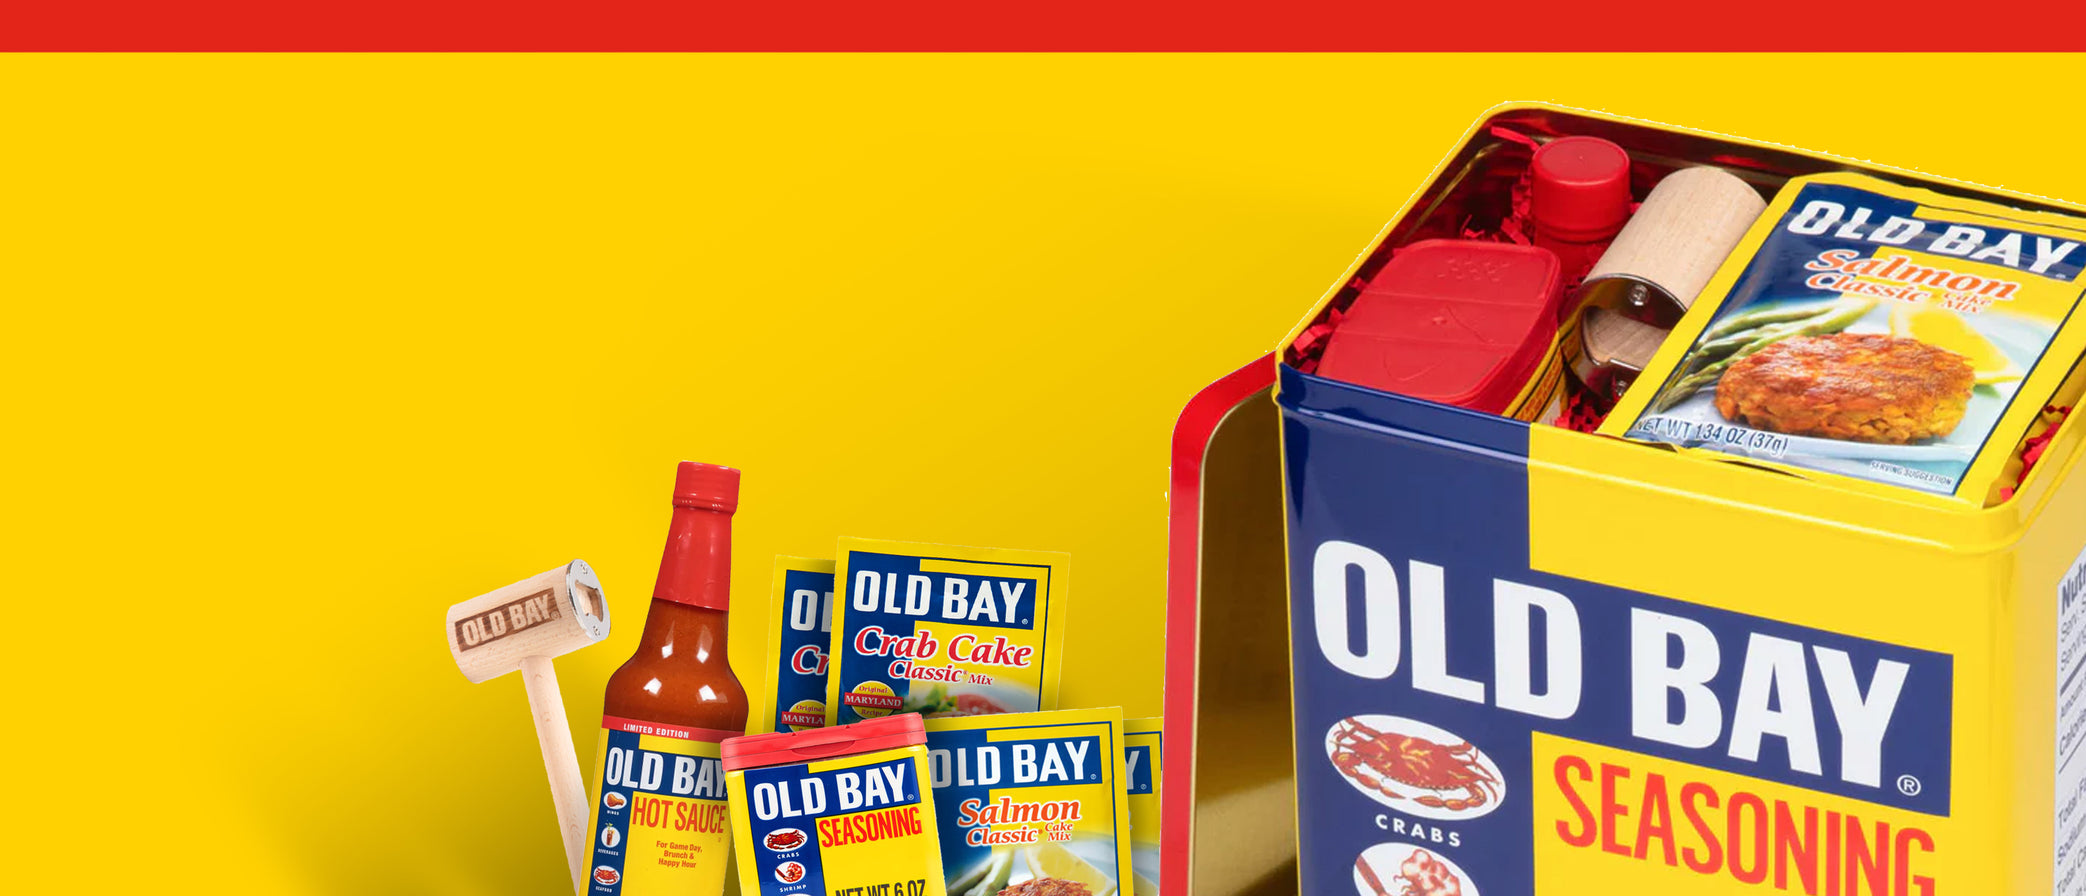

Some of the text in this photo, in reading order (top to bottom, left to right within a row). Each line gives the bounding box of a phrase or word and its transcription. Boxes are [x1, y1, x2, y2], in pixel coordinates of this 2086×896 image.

[1787, 200, 2080, 274] OLD BAY
[1806, 250, 2018, 299] Salmon
[1807, 273, 1929, 303] Classic
[1668, 419, 1693, 439] WT
[1726, 427, 1747, 445] OZ
[853, 570, 1026, 624] OLD BAY
[462, 594, 552, 647] OLD BAY
[855, 626, 1032, 666] Crab Cake
[889, 660, 993, 685] Classic Mix
[1313, 540, 1910, 789] OLD BAY
[845, 694, 902, 708] MARYLAND
[858, 685, 888, 694] Original
[861, 708, 884, 717] Recipe
[623, 723, 689, 739] LIMITED EDITION
[606, 746, 664, 791] OLD
[927, 740, 1090, 789] OLD BAY
[753, 763, 905, 821] OLD BAY
[632, 796, 727, 834] HOT SAUCE
[958, 797, 1081, 826] Salmon
[1553, 754, 1936, 896] SEASONING
[819, 806, 923, 848] SEASONING
[967, 827, 1038, 846] Classic
[1045, 821, 1073, 832] Cake
[1048, 831, 1071, 842] Mix
[1375, 814, 1462, 849] CRABS
[656, 840, 703, 854] For Game Day,
[664, 850, 695, 860] Brunch &
[777, 851, 800, 860] CRABS
[658, 858, 697, 869] Happy Hour
[780, 884, 807, 893] SHRIMP
